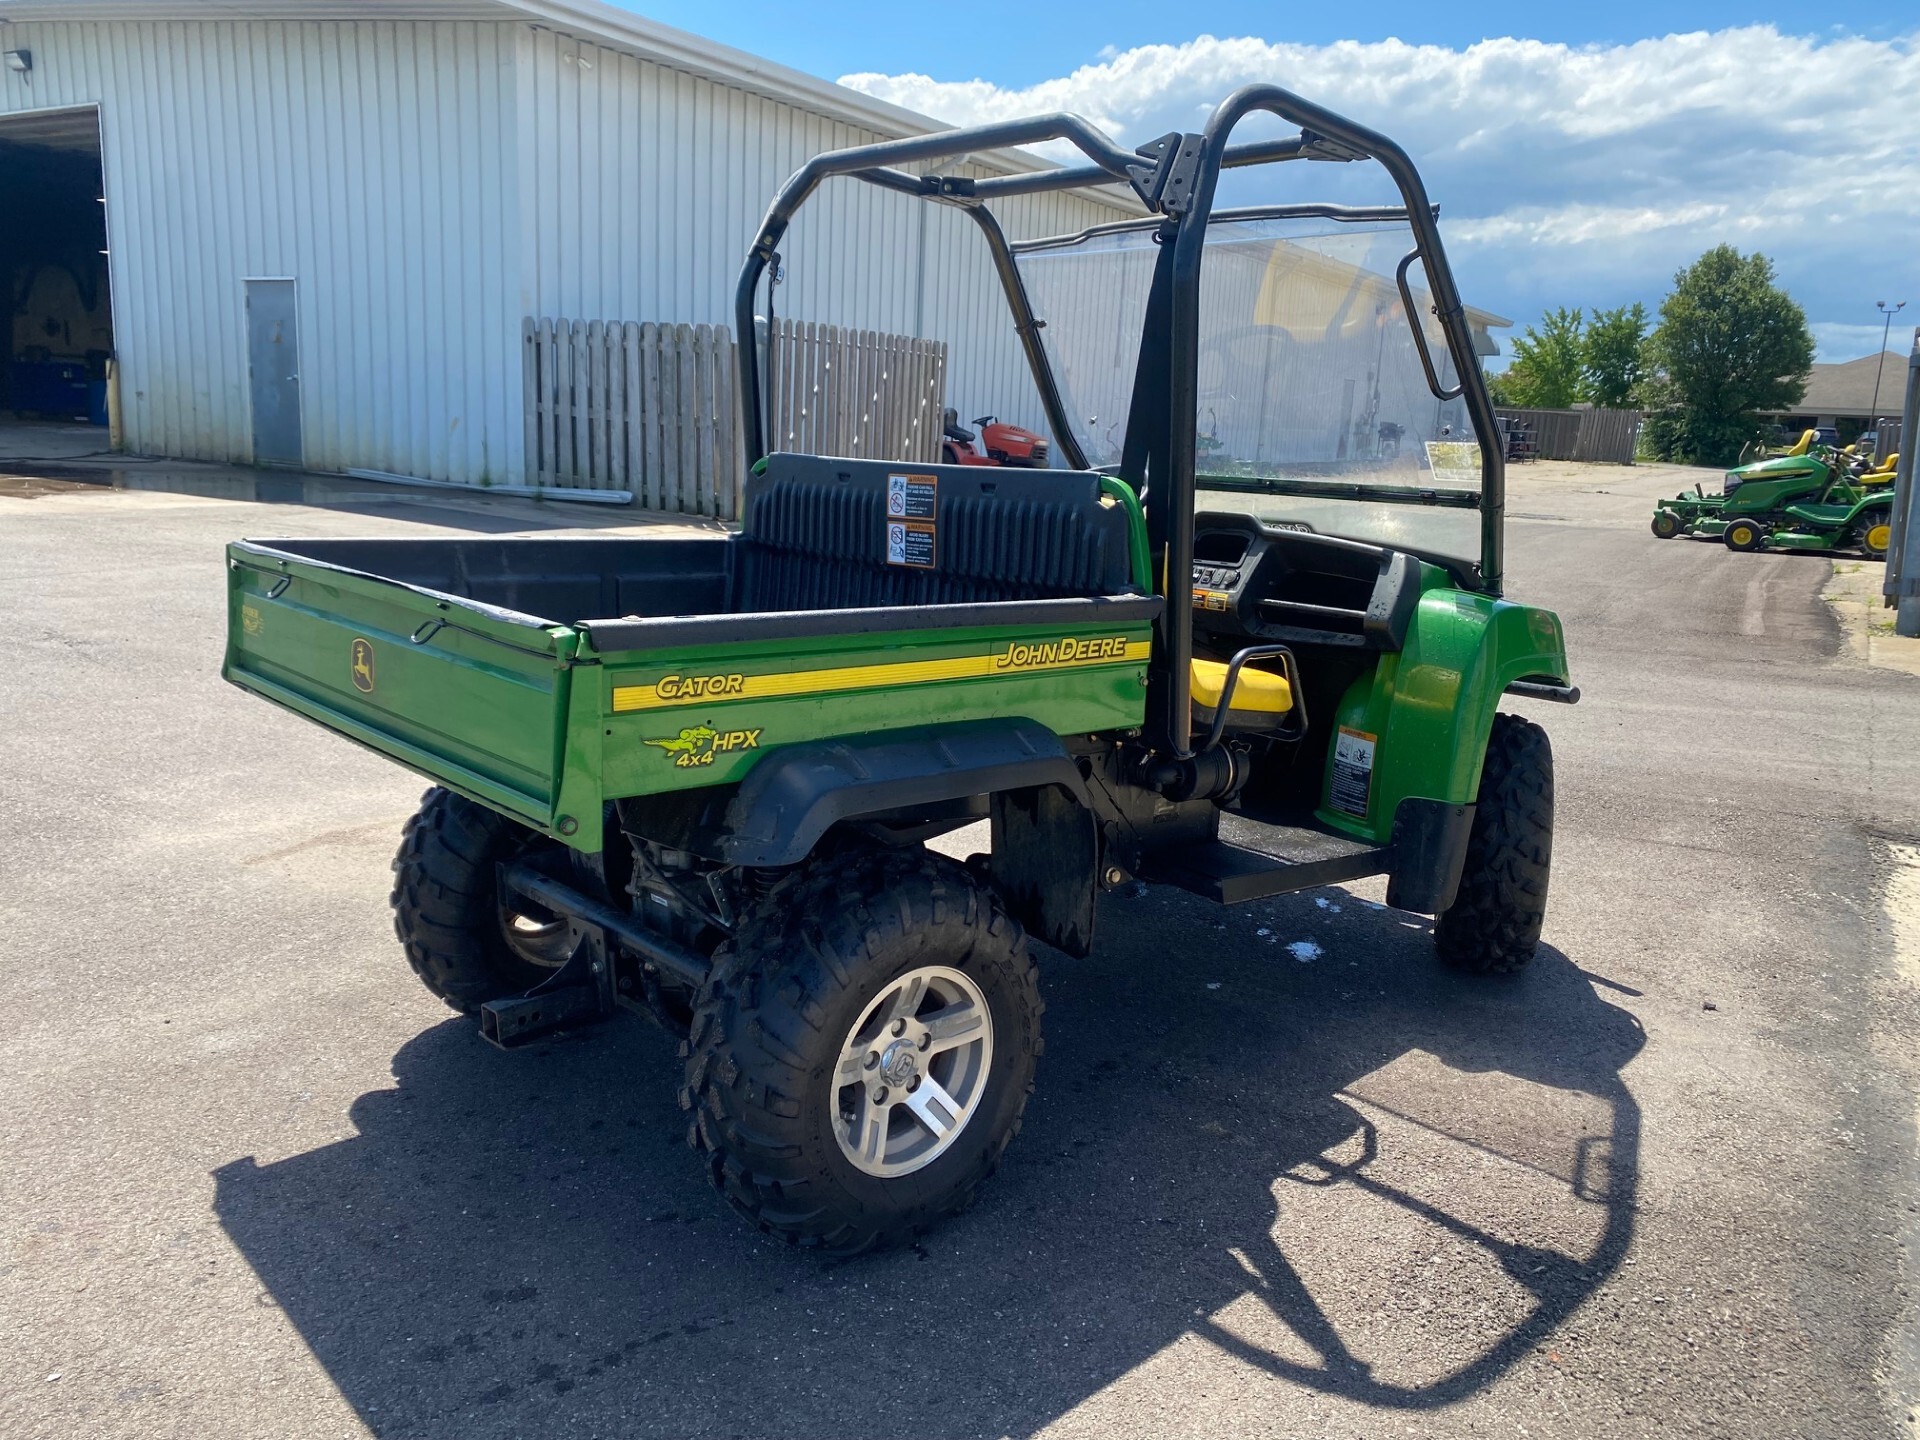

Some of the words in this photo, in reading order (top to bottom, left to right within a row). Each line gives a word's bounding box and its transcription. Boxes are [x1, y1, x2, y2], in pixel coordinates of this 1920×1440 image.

[997, 642, 1058, 668] JOHN
[1058, 637, 1127, 661] DEERE
[656, 674, 744, 699] GATOR
[711, 729, 762, 752] HPX
[676, 750, 714, 767] 4x4
